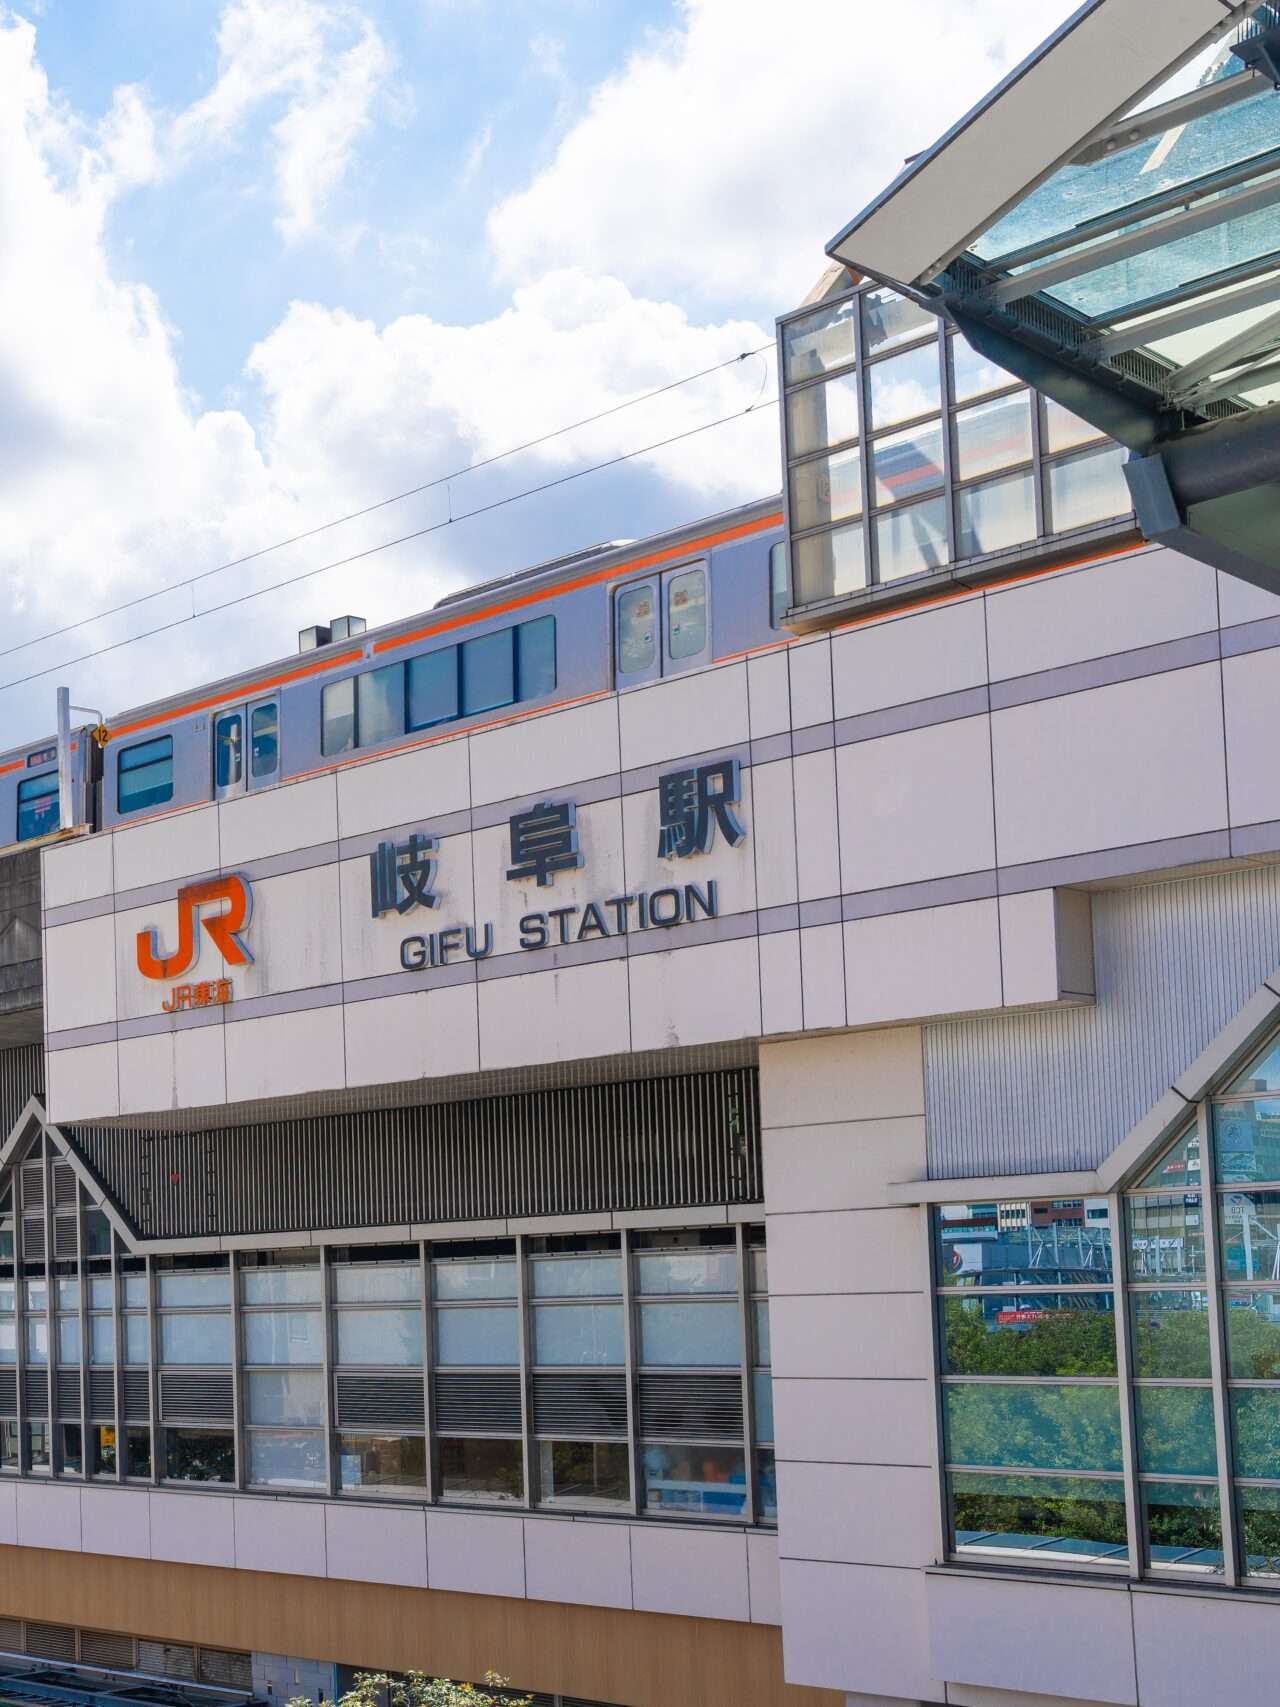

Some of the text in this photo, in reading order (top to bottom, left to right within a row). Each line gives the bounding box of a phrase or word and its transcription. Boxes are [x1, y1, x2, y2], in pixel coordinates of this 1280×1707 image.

[98, 728, 109, 743] 12
[370, 760, 743, 918] 岐阜駅
[136, 874, 253, 980] JR
[401, 879, 718, 969] GIFU STATION
